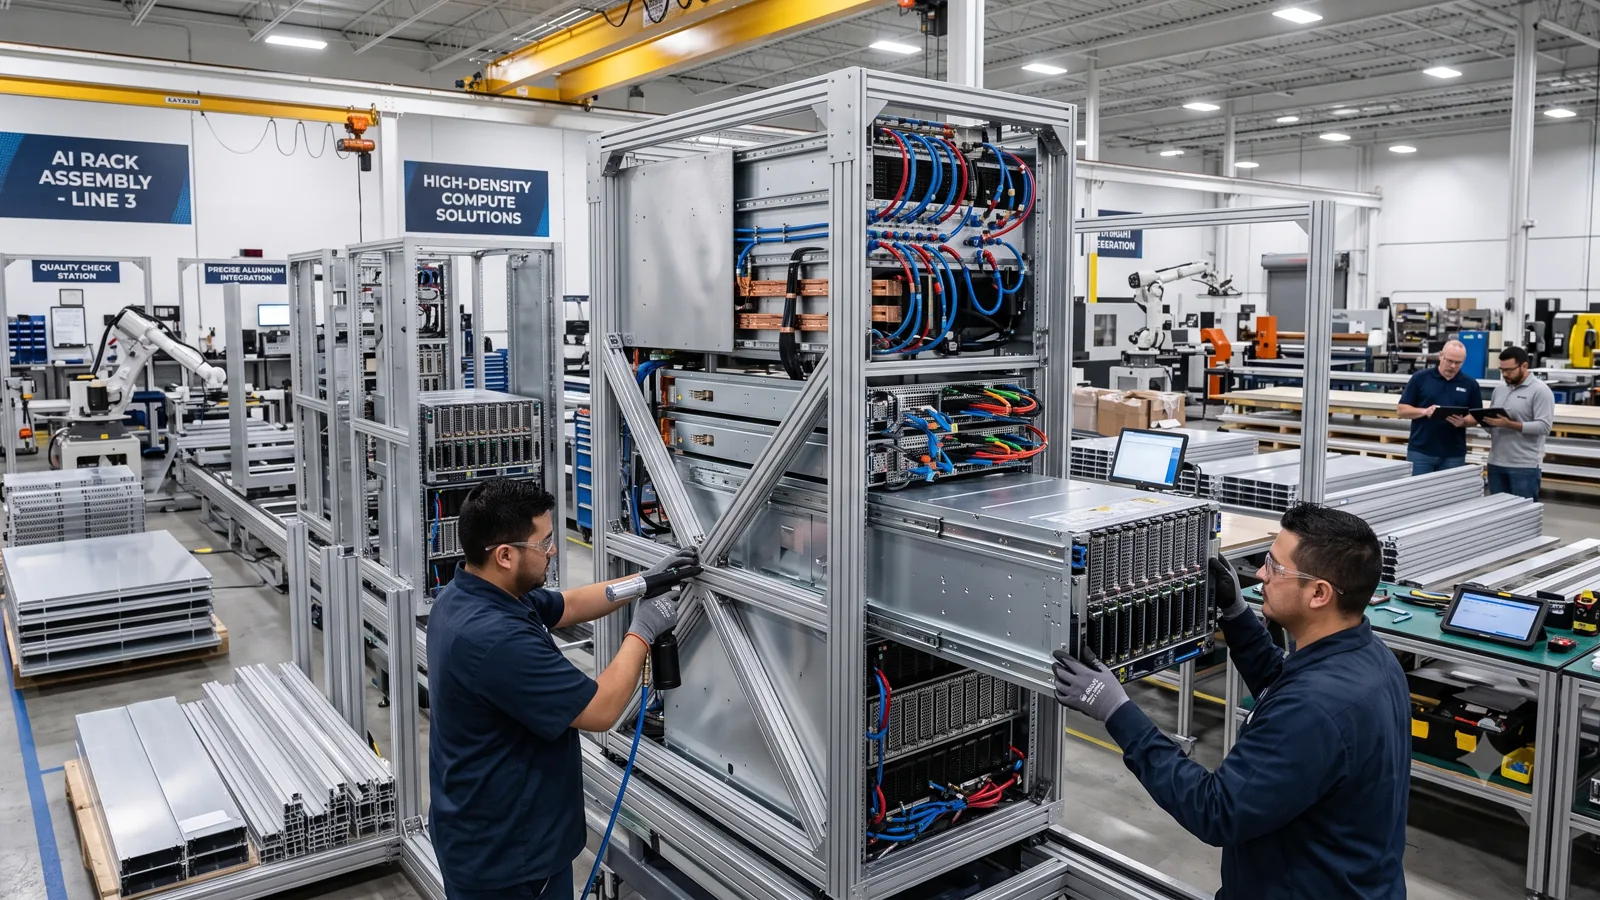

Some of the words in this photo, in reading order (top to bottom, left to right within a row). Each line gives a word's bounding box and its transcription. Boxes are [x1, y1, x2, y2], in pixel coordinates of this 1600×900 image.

[52, 151, 74, 166] AI
[81, 152, 139, 170] RACK
[39, 170, 152, 190] ASSEMBLY
[423, 174, 531, 193] HIGH-DENSITY
[71, 191, 119, 208] LINE
[125, 194, 137, 209] 3
[441, 192, 516, 208] COMPUTE
[436, 208, 522, 224] SOLUTIONS
[40, 263, 80, 271] QUALITY
[81, 264, 112, 272] CHECK
[207, 266, 240, 274] PRECISE
[57, 272, 96, 280] STATION
